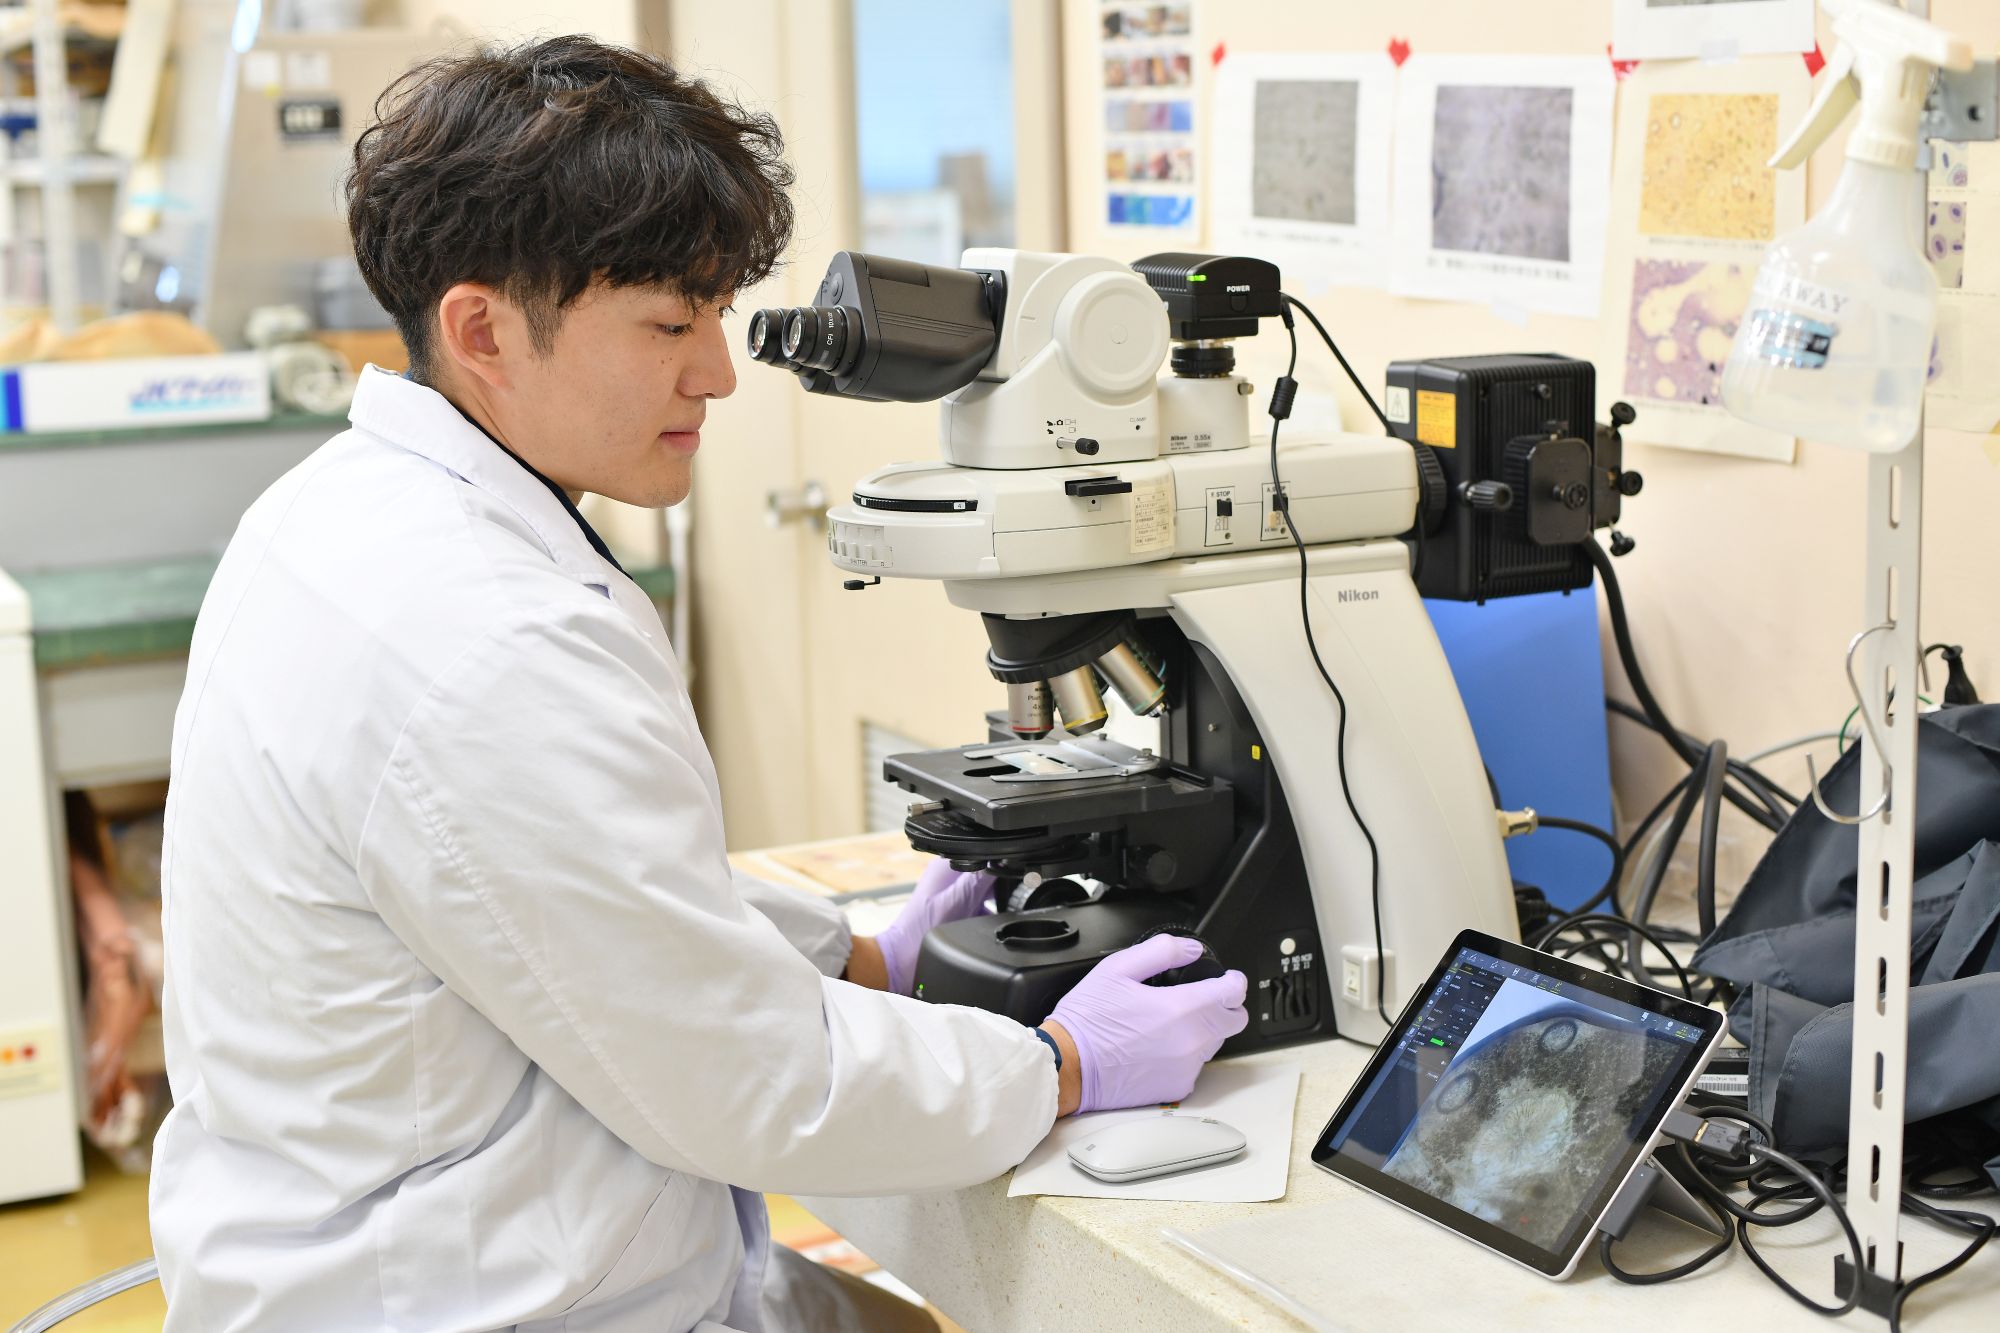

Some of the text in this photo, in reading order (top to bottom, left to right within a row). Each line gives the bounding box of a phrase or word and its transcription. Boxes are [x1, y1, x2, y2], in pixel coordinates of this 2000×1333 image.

[1226, 285, 1250, 293] POWER
[826, 333, 834, 346] CFI
[1338, 589, 1379, 603] Nikon
